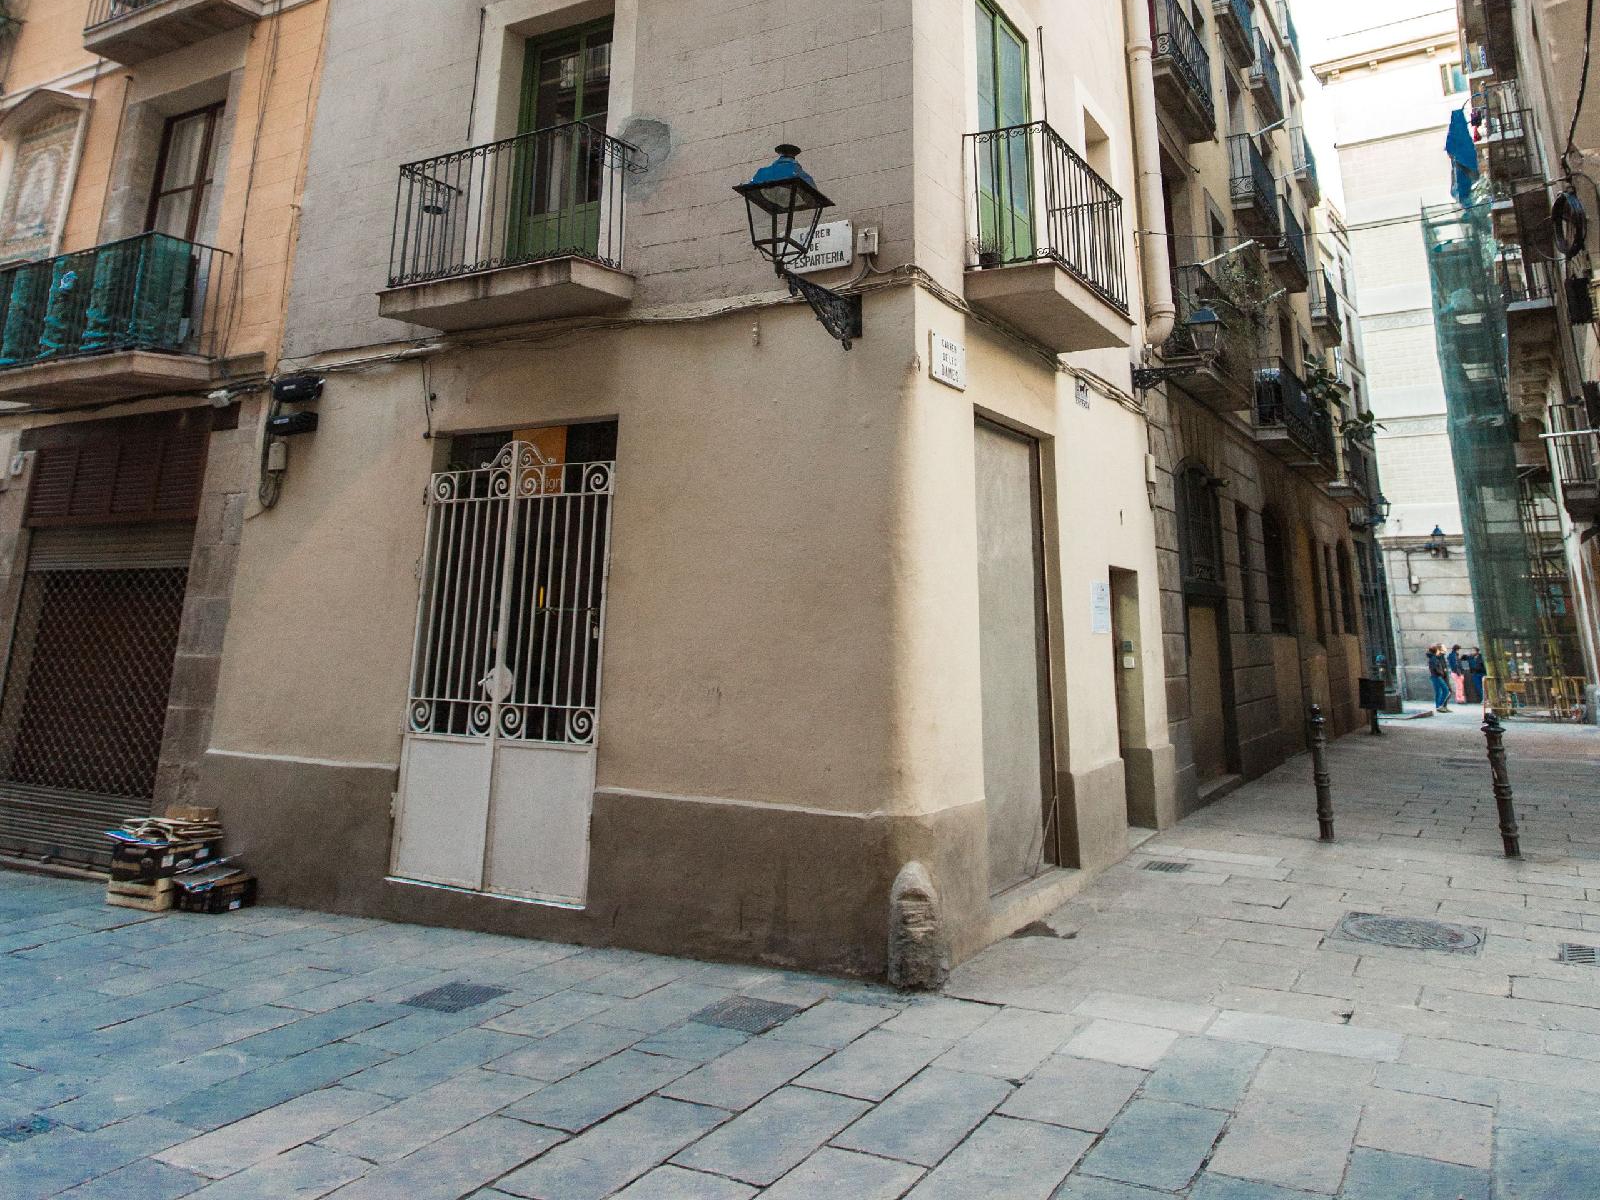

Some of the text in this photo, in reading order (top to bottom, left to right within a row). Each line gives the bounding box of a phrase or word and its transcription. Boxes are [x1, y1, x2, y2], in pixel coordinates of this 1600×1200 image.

[800, 228, 831, 241] CRER
[809, 242, 820, 252] DE
[785, 250, 845, 270] LESPARTERIA
